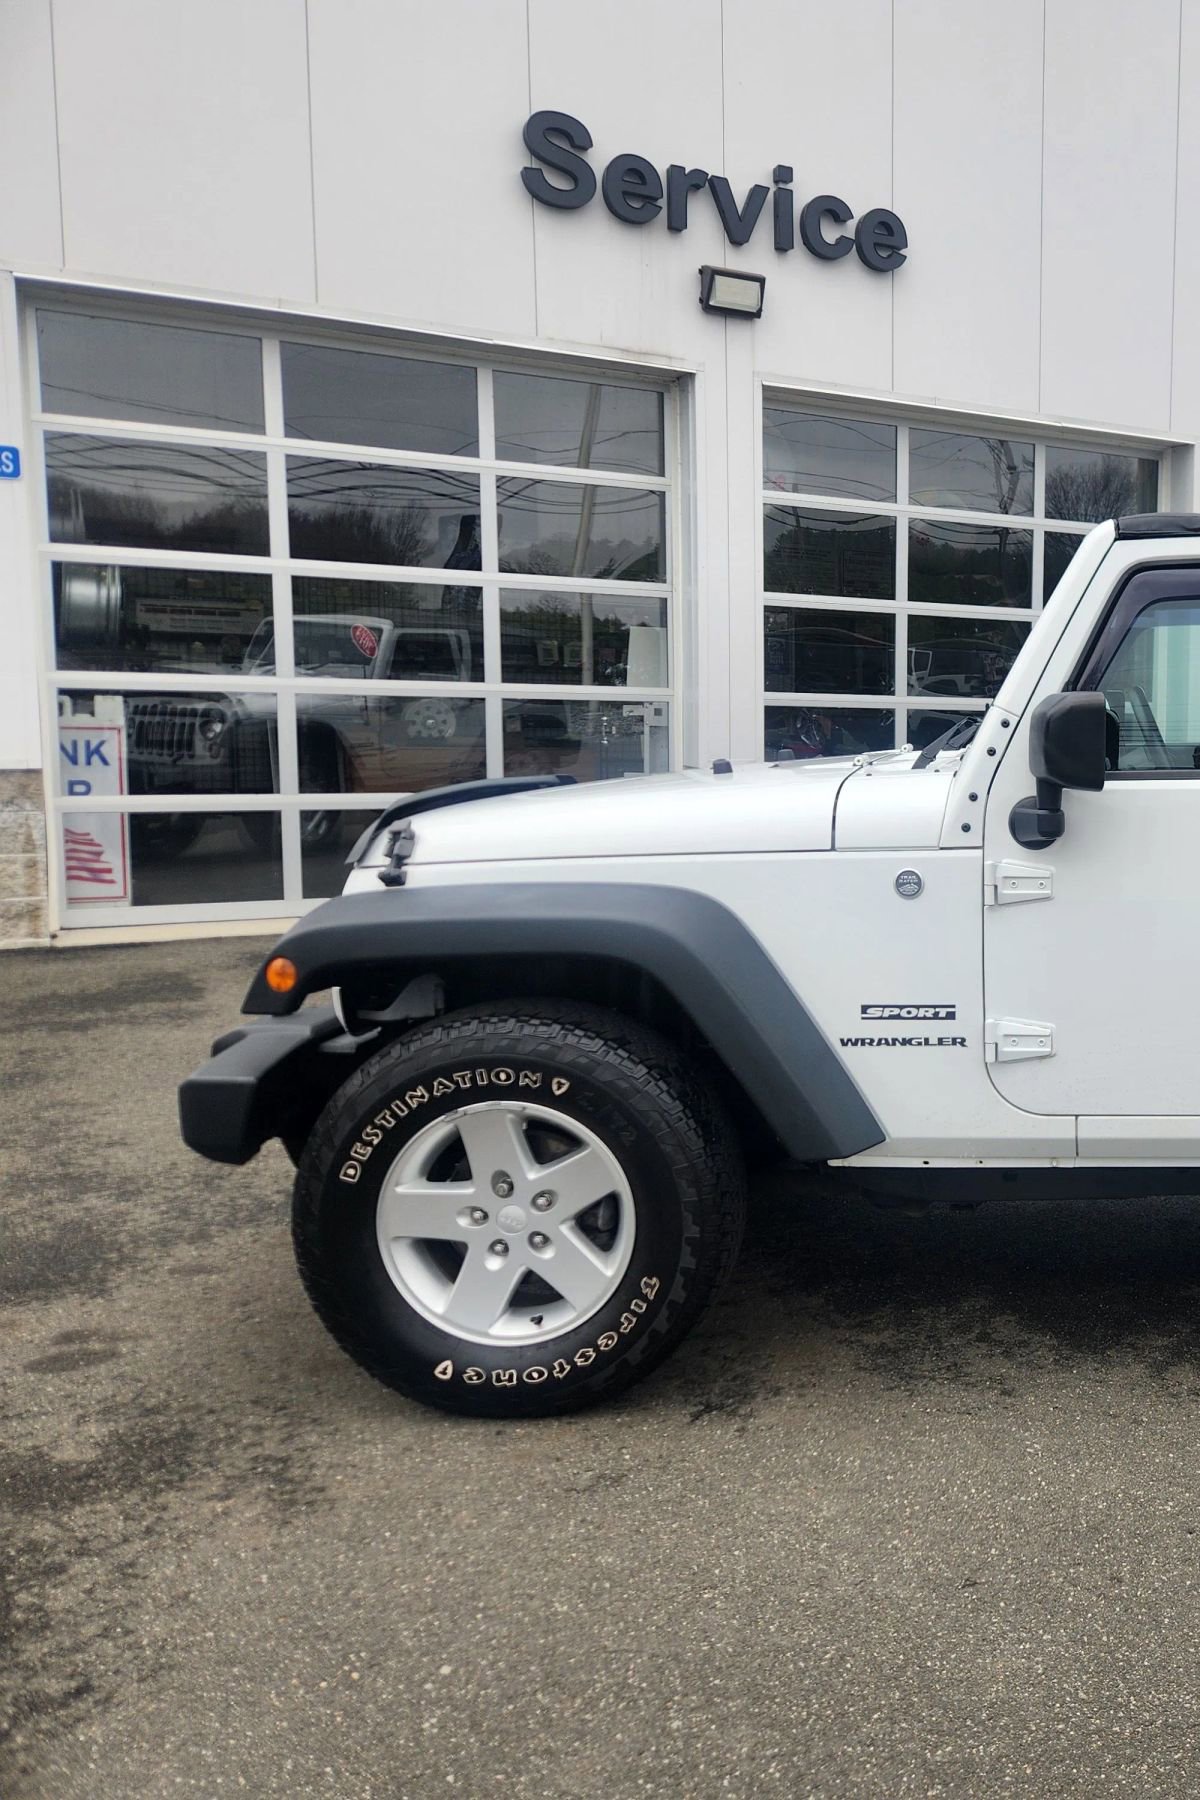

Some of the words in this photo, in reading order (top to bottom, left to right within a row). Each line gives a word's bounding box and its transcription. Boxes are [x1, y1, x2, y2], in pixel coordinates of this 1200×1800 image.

[520, 110, 909, 273] Service
[0, 450, 15, 474] S
[861, 1005, 956, 1020] SPORT
[839, 1036, 968, 1048] WRANGLER
[339, 1067, 543, 1184] DESTINATION
